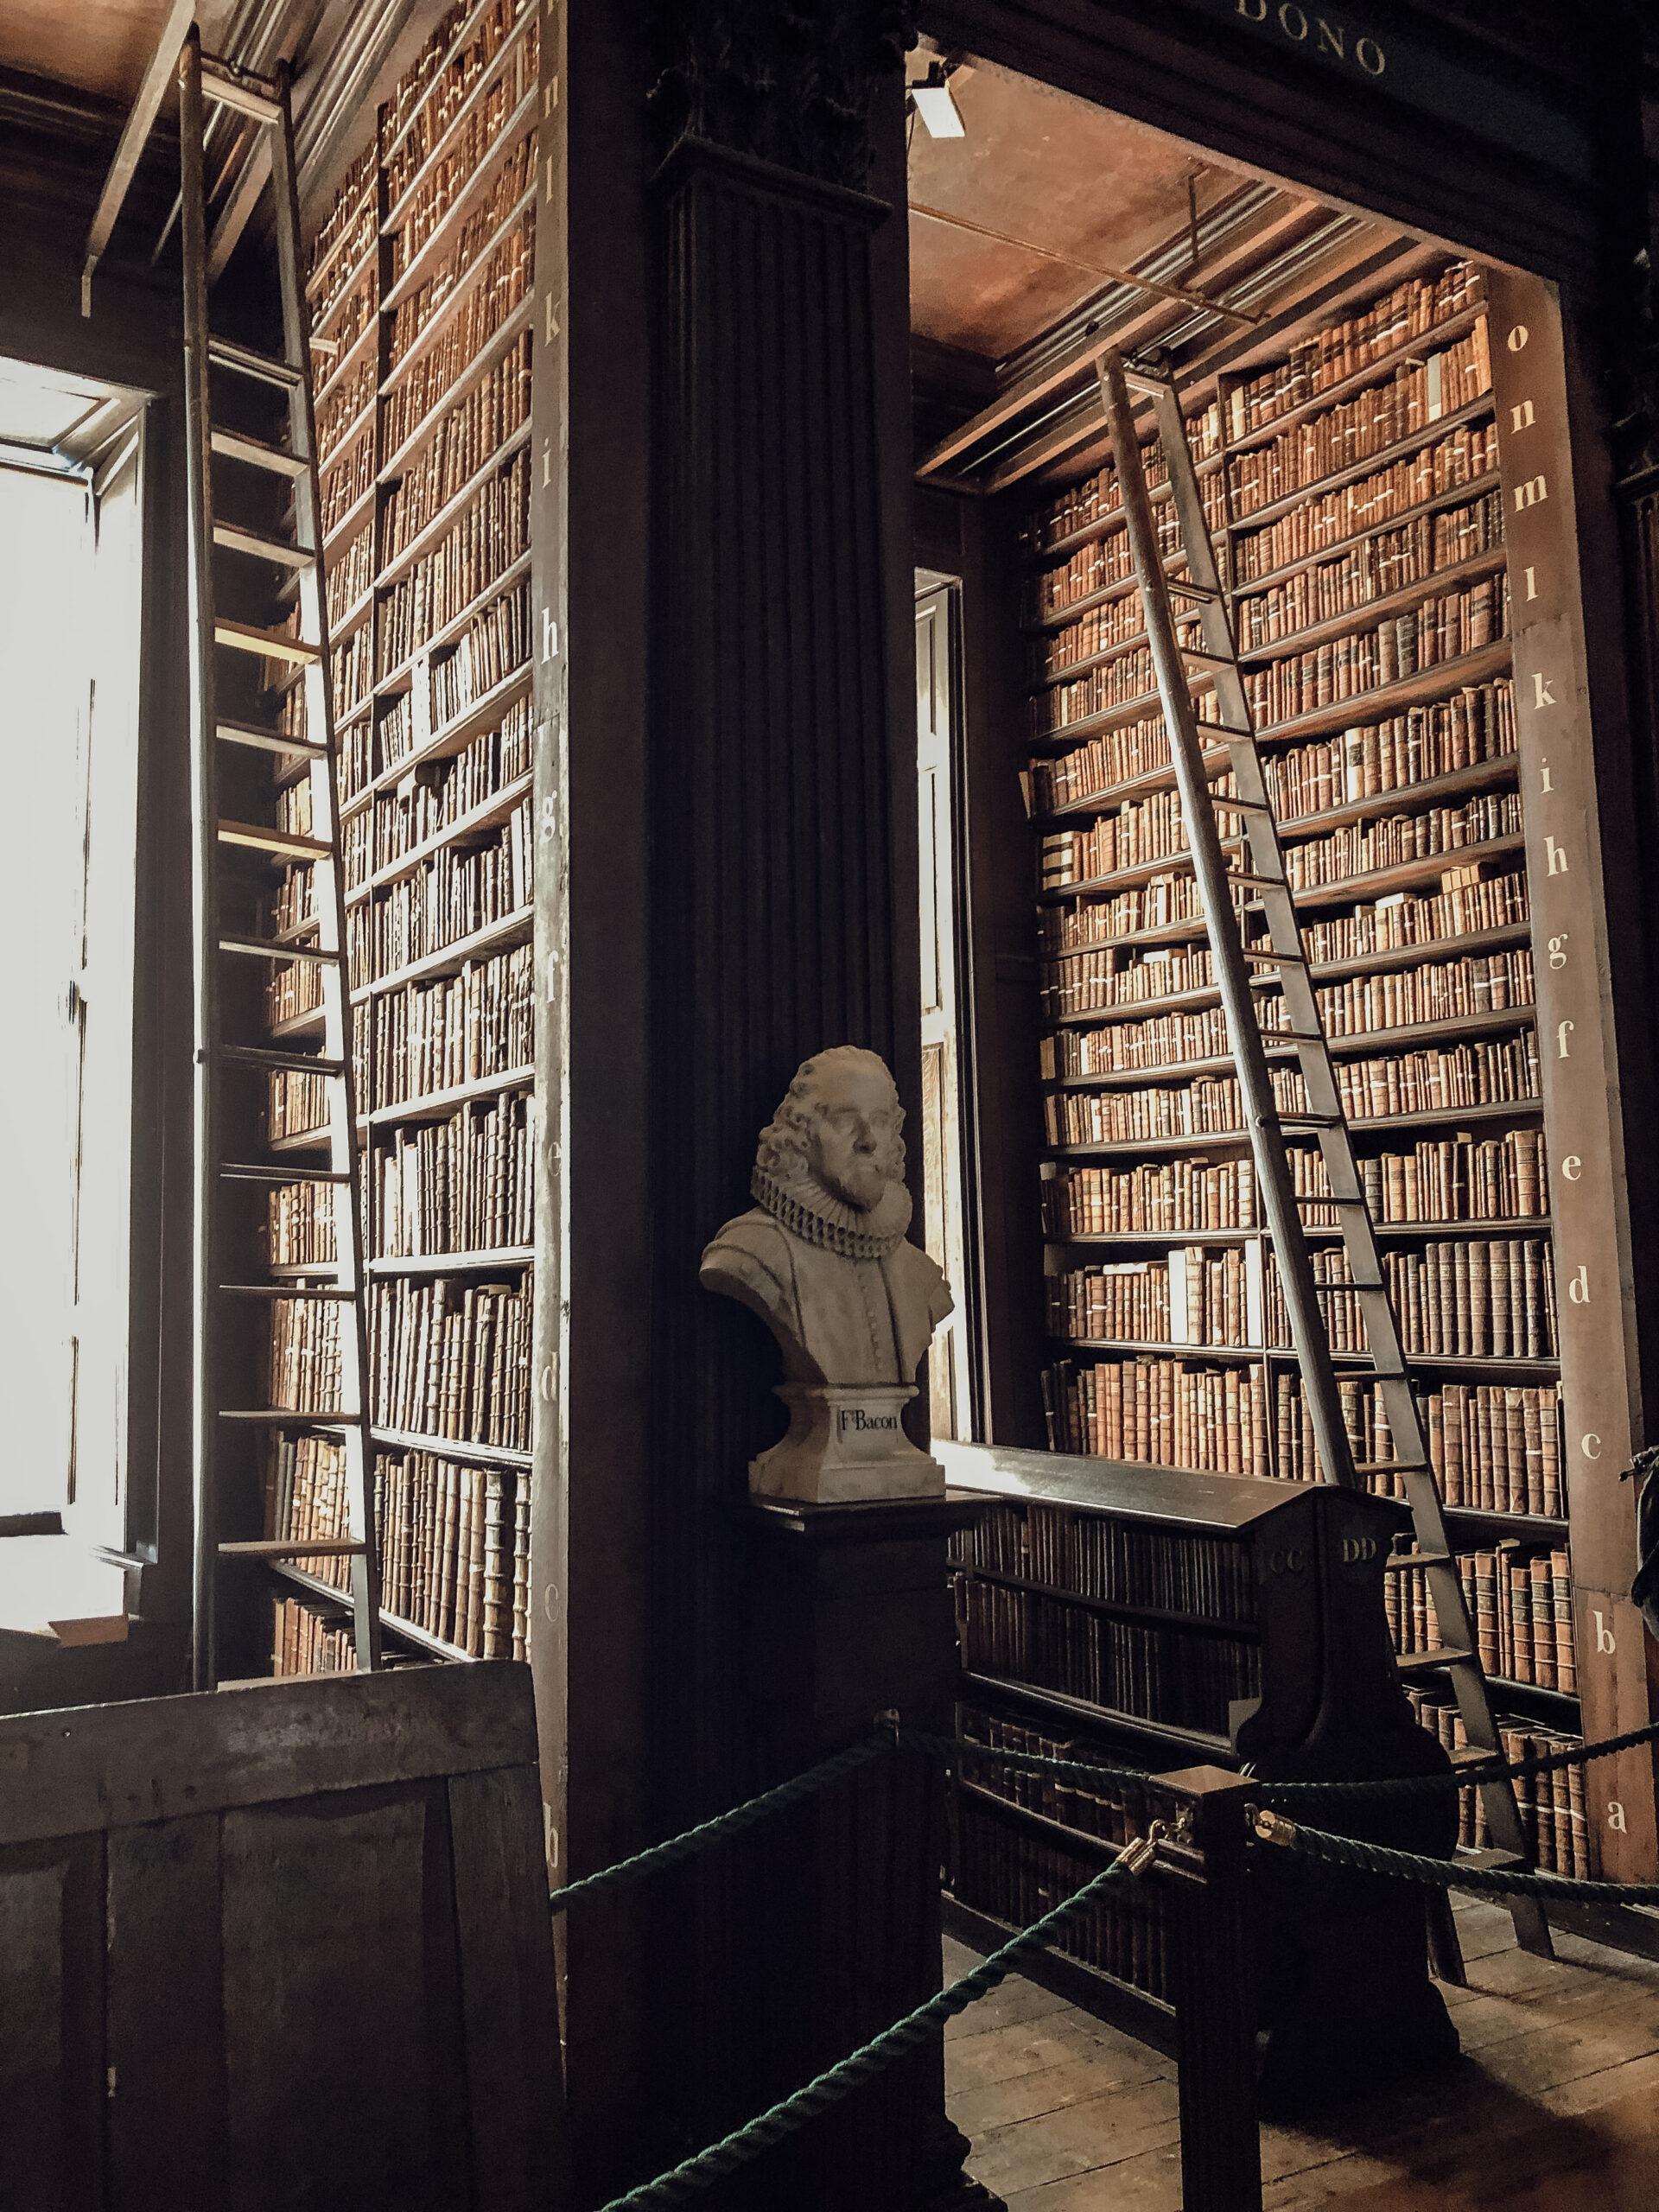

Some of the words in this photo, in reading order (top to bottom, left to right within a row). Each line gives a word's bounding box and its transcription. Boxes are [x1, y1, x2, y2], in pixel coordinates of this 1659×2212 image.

[544, 290, 561, 347] k
[1507, 325, 1529, 352] o
[1510, 399, 1536, 434] n
[542, 437, 551, 489] i
[1514, 474, 1548, 512] m
[1522, 566, 1538, 602] l
[541, 607, 559, 664] h
[1531, 672, 1557, 709] k
[1540, 758, 1554, 793] i
[538, 790, 557, 845] g
[1543, 836, 1570, 877] h
[1548, 933, 1568, 969] g
[547, 950, 558, 1003] f
[1556, 1020, 1574, 1058] f
[548, 1141, 561, 1177] e
[1561, 1154, 1582, 1181] e
[1568, 1265, 1591, 1303] d
[541, 1351, 557, 1402] d
[855, 1409, 898, 1431] Bacon
[1581, 1433, 1602, 1460] c
[1343, 1536, 1377, 1563] DD
[544, 1583, 559, 1622] c
[1592, 1611, 1616, 1654] b
[543, 1802, 559, 1868] b
[1607, 1801, 1627, 1834] a
